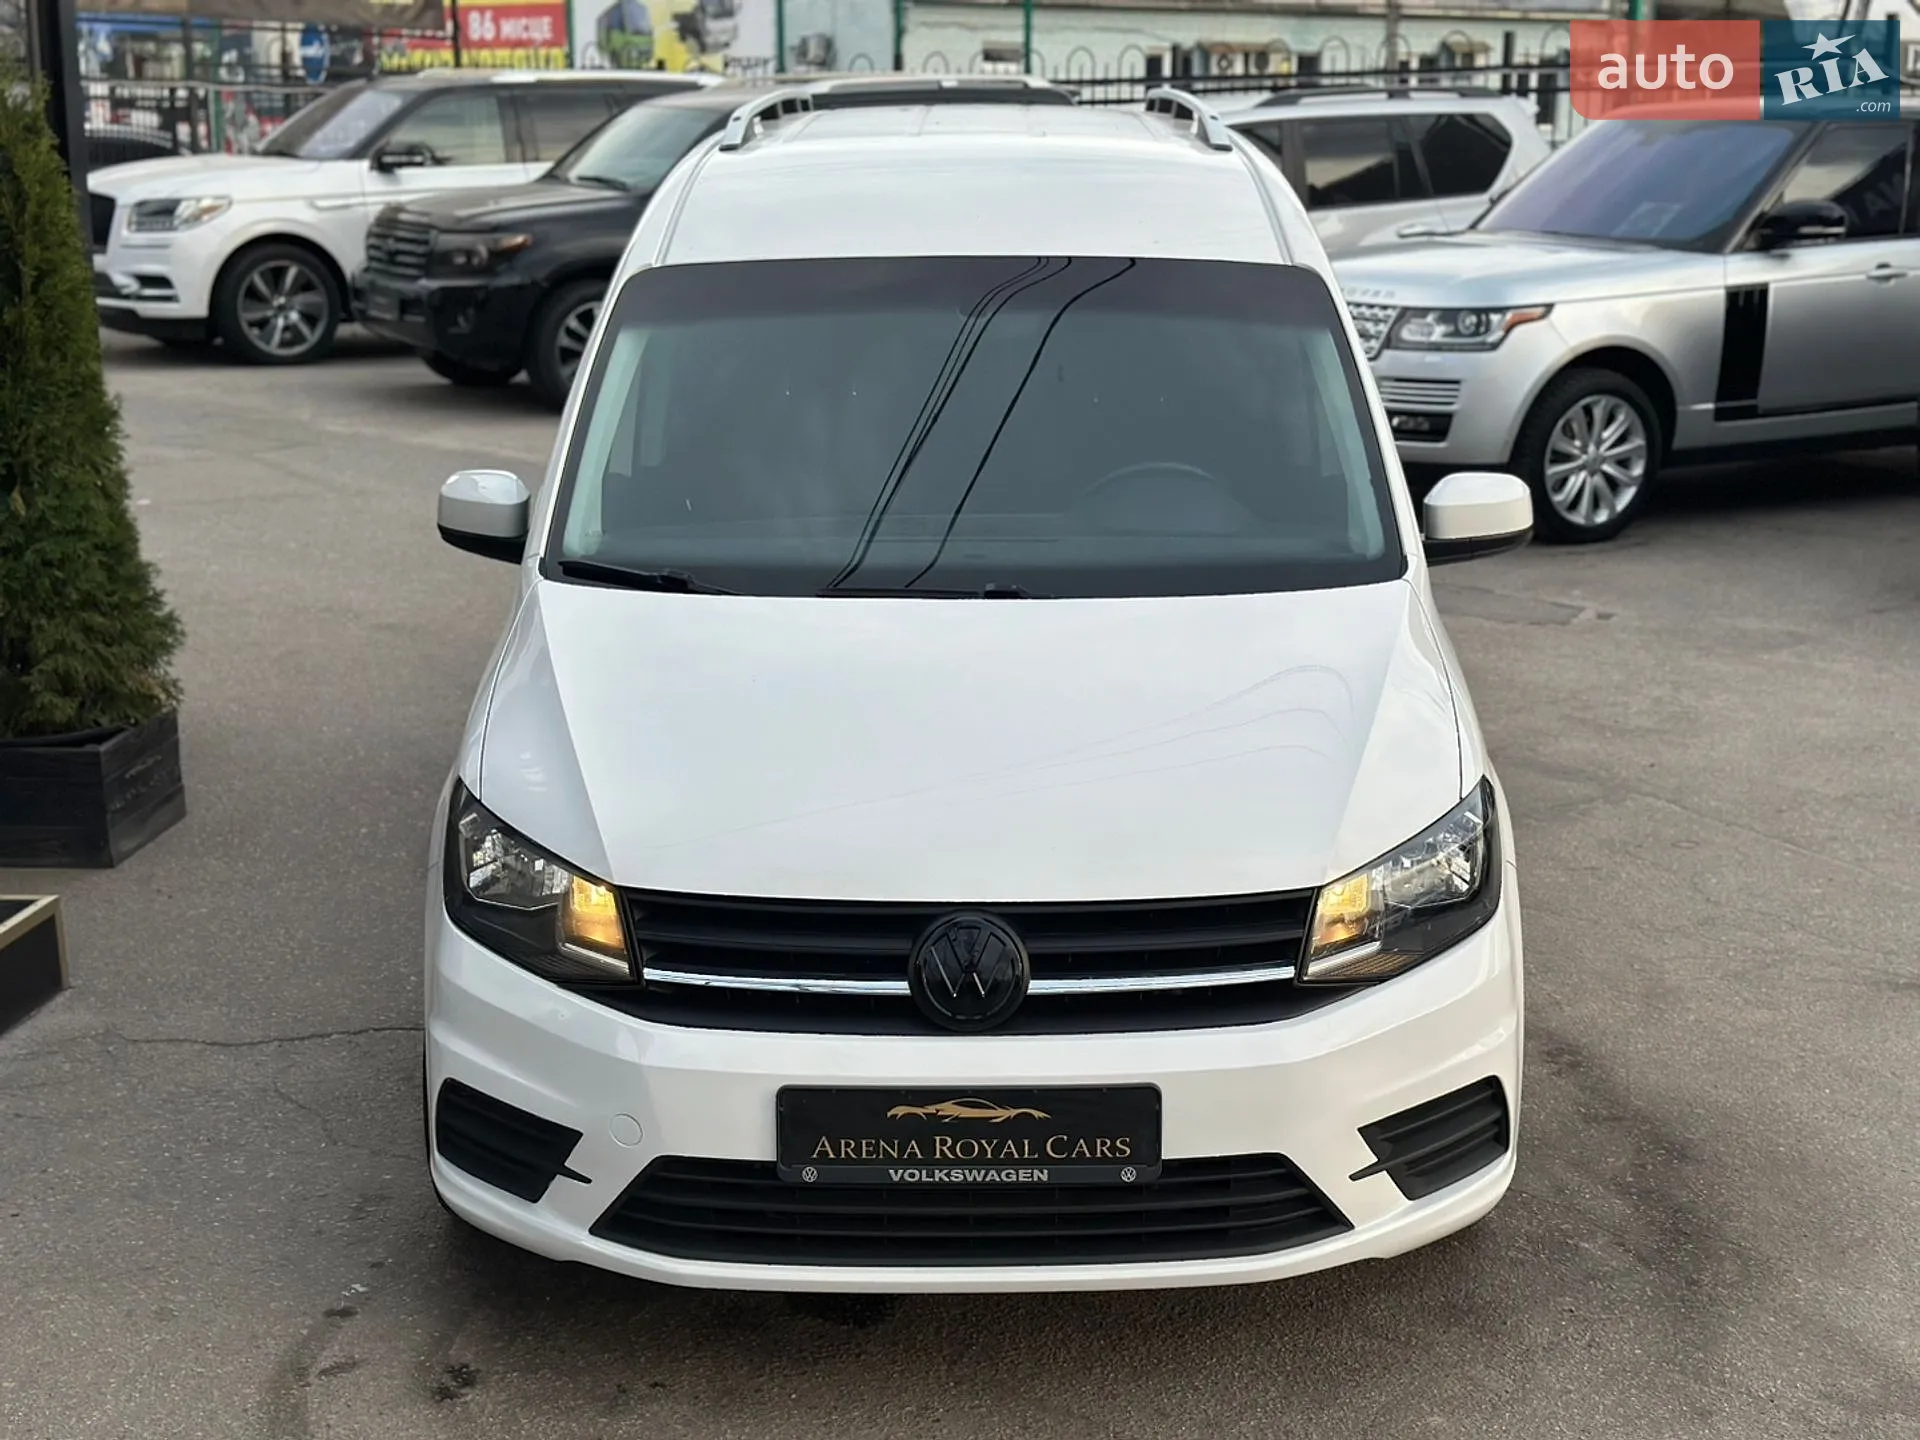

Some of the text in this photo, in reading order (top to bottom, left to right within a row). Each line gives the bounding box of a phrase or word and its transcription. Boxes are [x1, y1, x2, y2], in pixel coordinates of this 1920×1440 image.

[468, 10, 496, 41] 86
[811, 1134, 1132, 1160] ARENA ROYAL CARS
[888, 1168, 1049, 1183] VOLKSWAGEN
